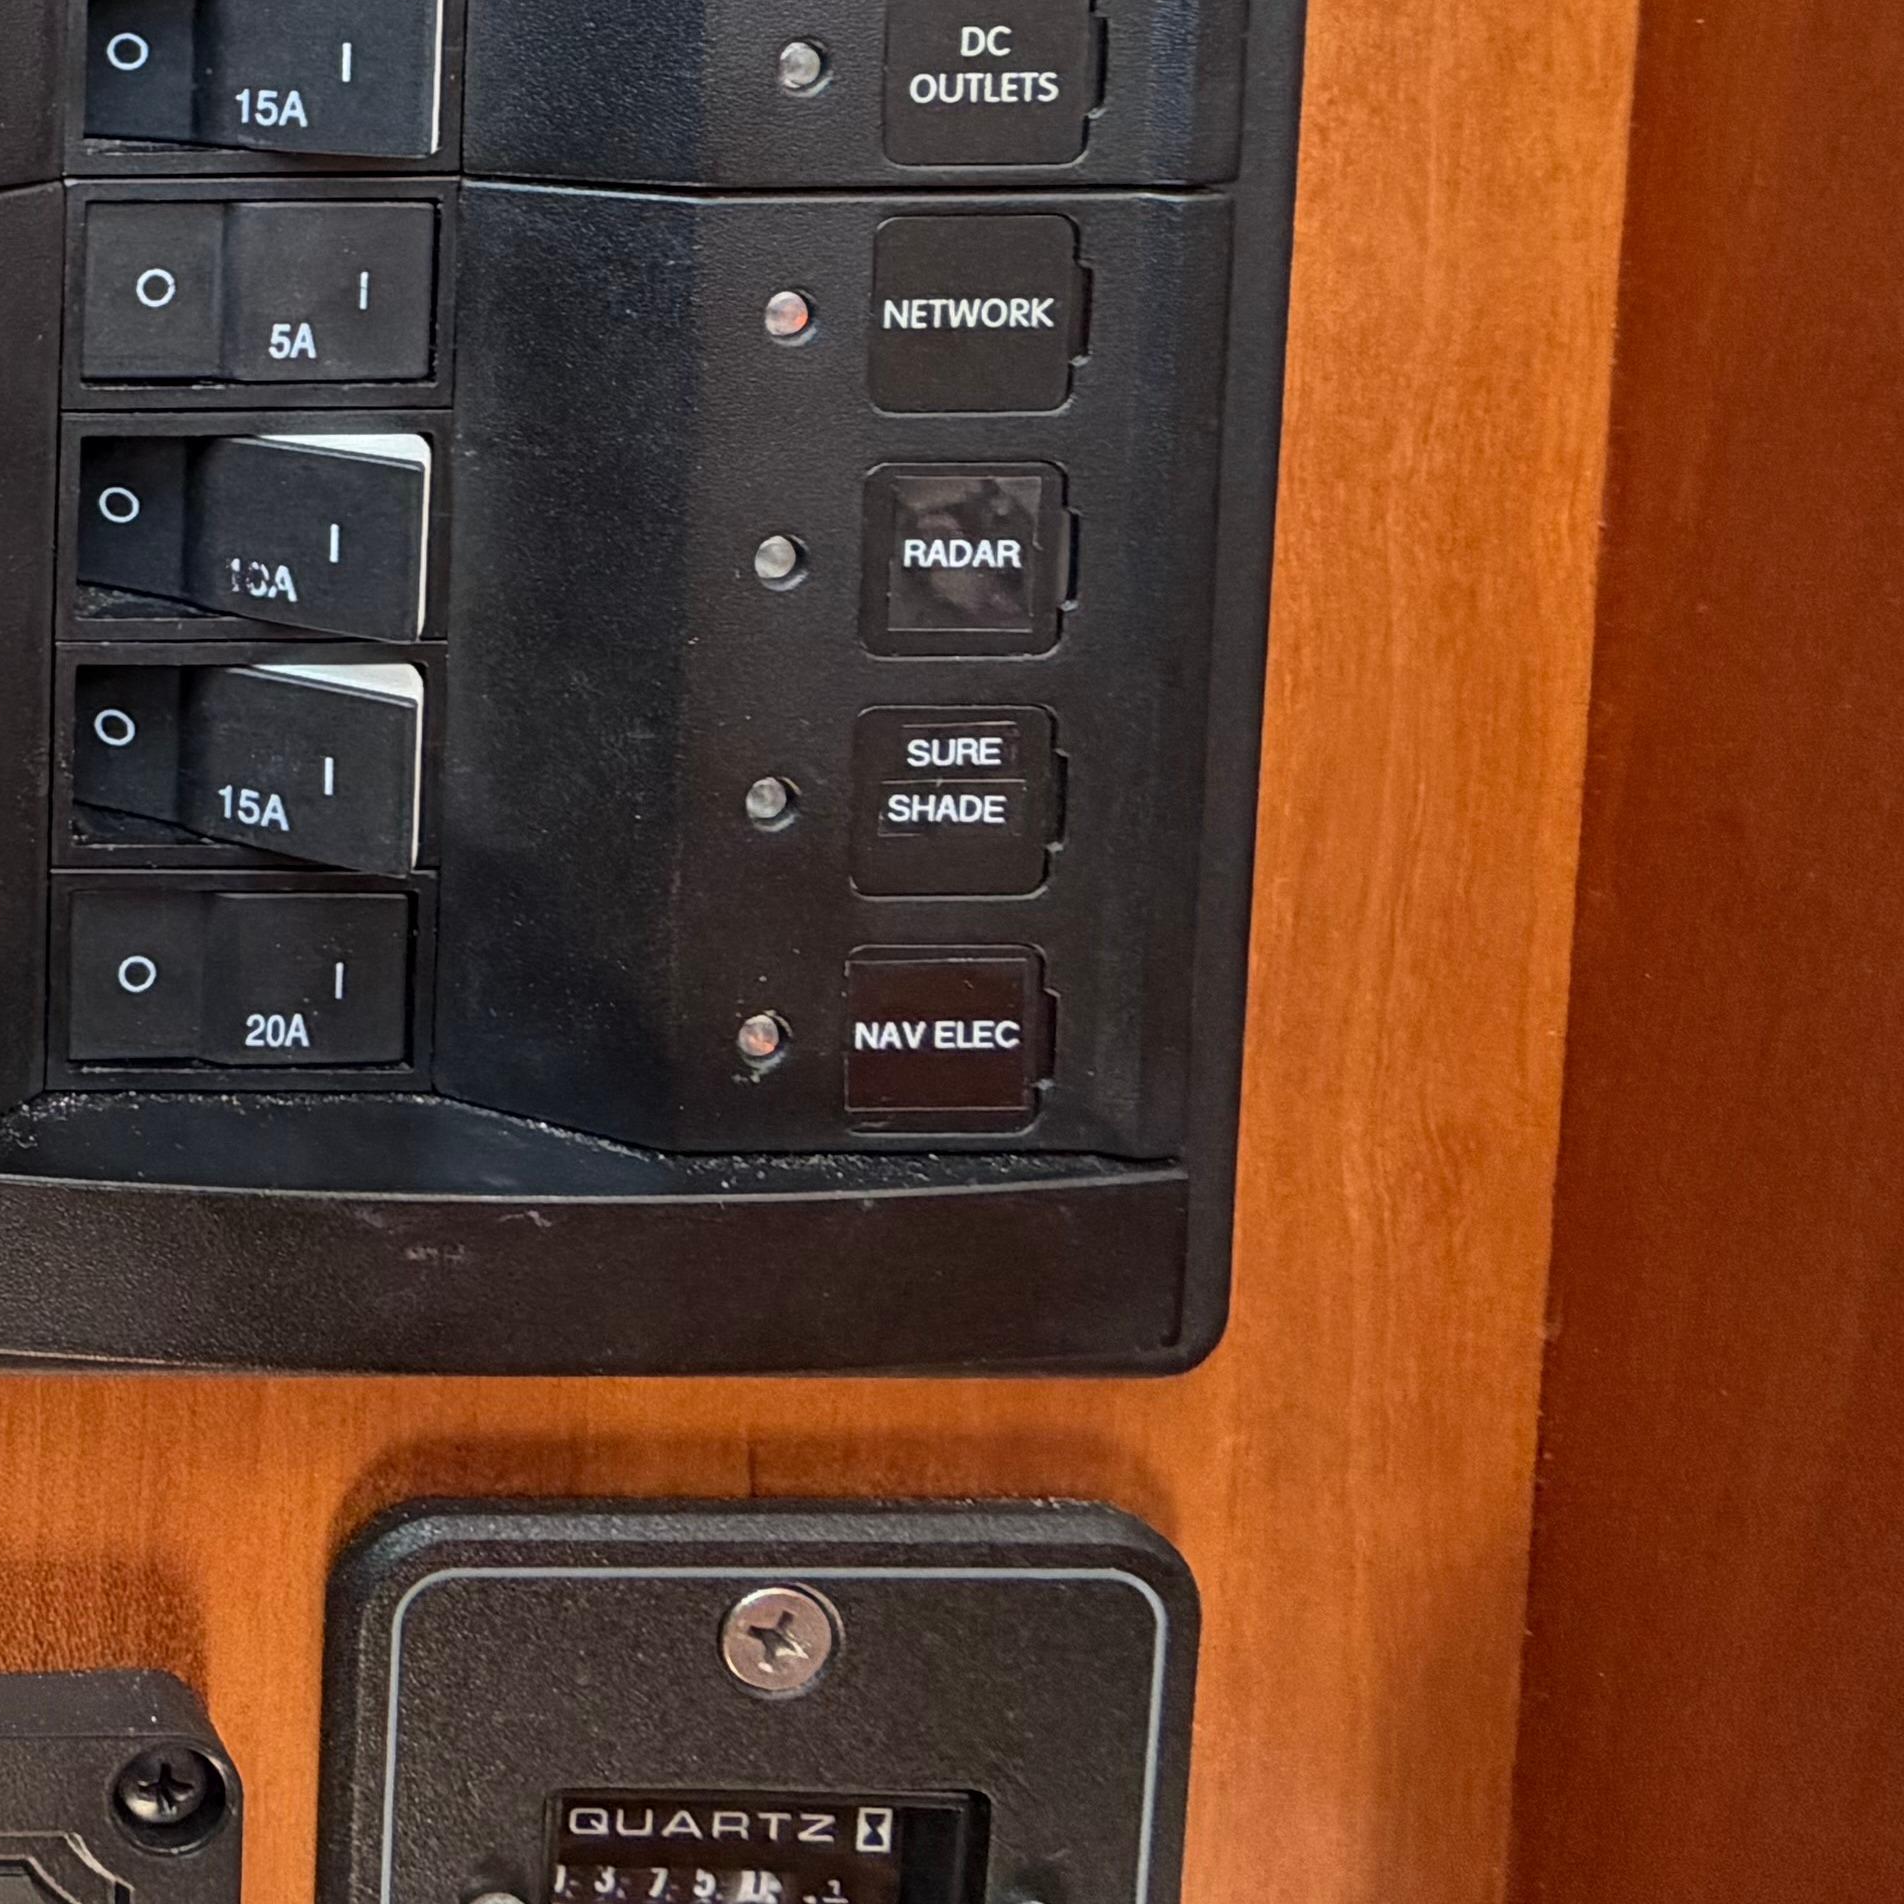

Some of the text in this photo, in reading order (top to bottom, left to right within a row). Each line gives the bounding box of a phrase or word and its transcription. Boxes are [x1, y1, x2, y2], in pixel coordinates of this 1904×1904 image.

[960, 25, 1012, 57] DC
[909, 71, 1059, 104] OUTLETS
[235, 88, 308, 128] 15A
[883, 297, 1054, 329] NETWORK
[268, 322, 317, 360] 5A
[903, 539, 1022, 568] RADAR
[906, 737, 1003, 767] SURE
[218, 784, 290, 832] 15A
[887, 794, 1007, 824] SHADE
[244, 1013, 310, 1048] 20A
[854, 1020, 1020, 1050] NAV ELEC
[568, 1807, 836, 1843] QUARTZ
